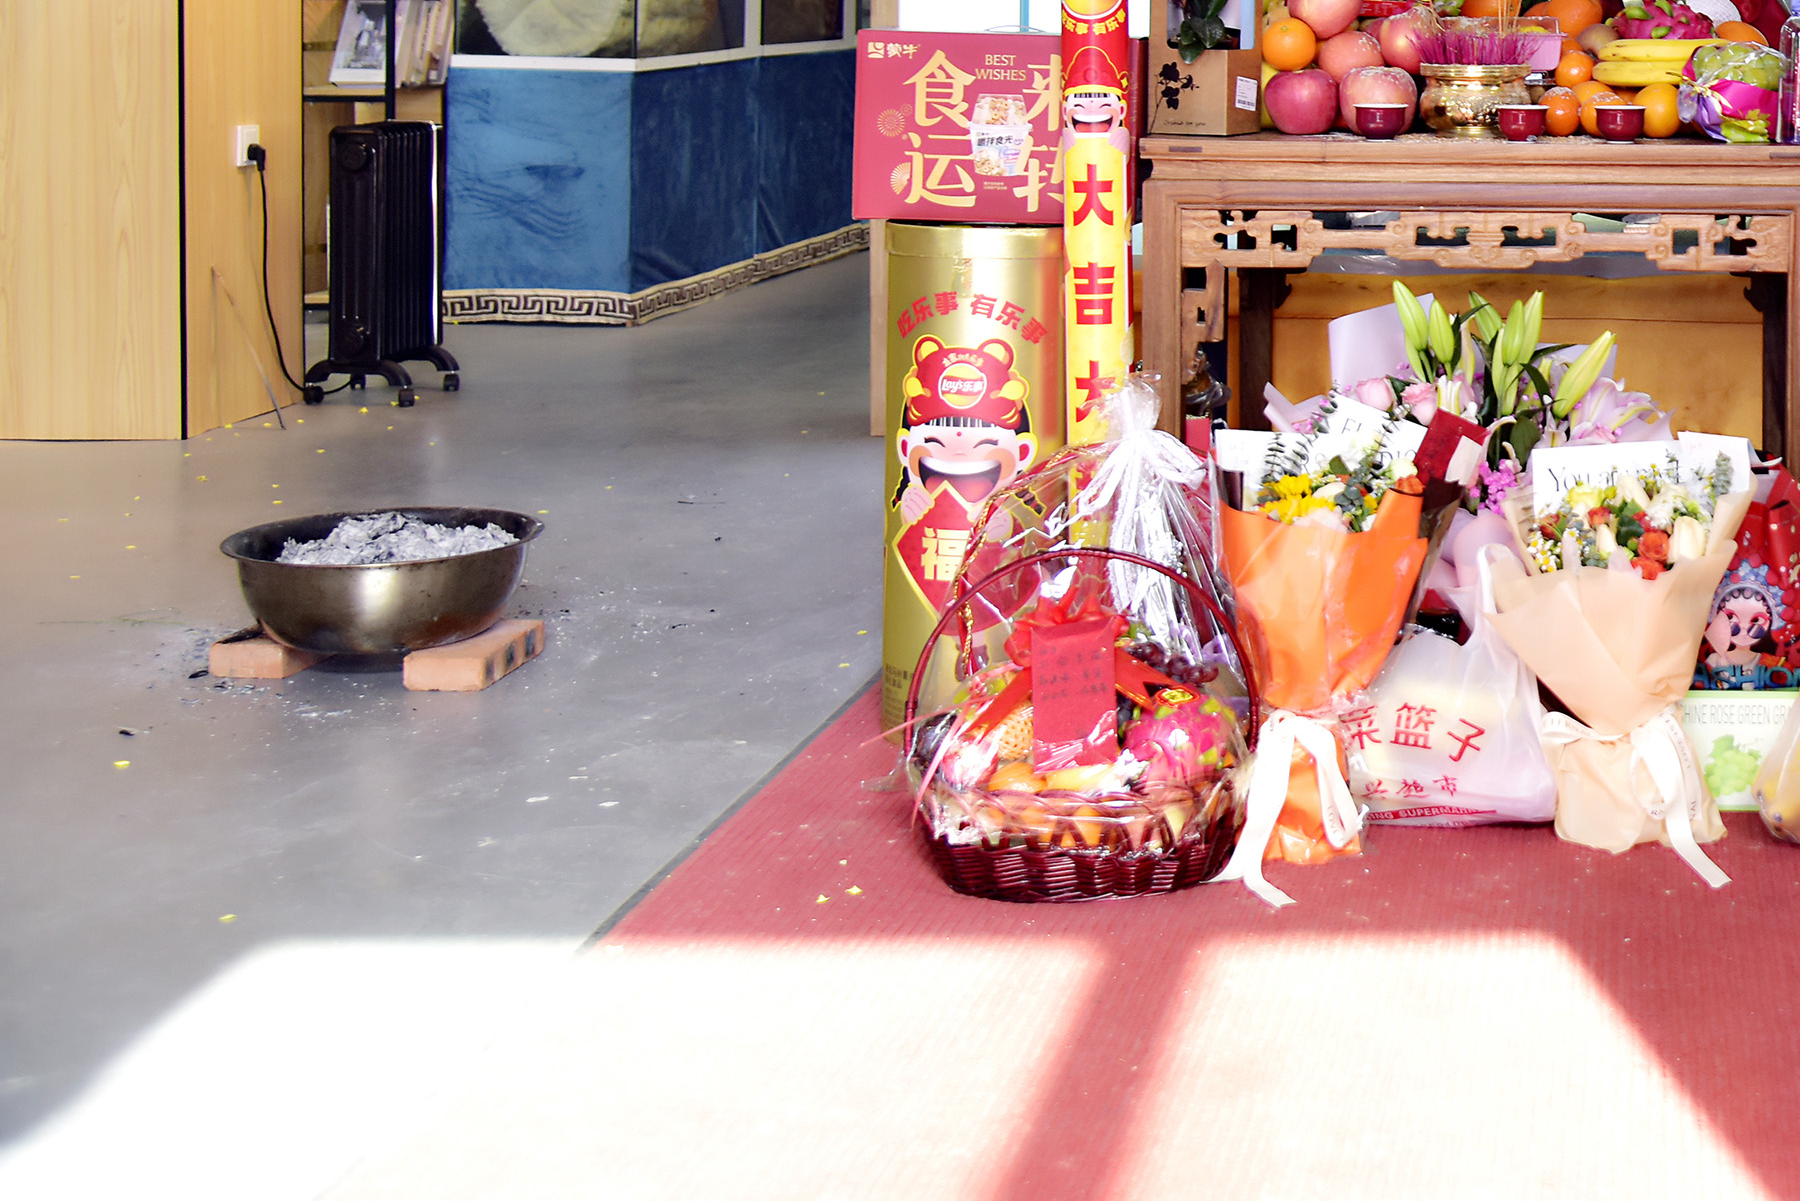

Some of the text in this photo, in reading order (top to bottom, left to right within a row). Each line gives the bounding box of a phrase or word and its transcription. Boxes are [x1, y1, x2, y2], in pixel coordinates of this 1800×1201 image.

[886, 42, 918, 60] 蒙牛
[985, 54, 1016, 67] BEST
[975, 69, 1027, 81] WISHES
[897, 291, 1048, 345] 吃乐事 有乐事
[920, 527, 969, 582] 福
[1684, 704, 1707, 725] HINE
[1710, 704, 1735, 725] ROSE
[1738, 704, 1770, 725] GREEN
[1400, 806, 1484, 818] SUPERMAR
